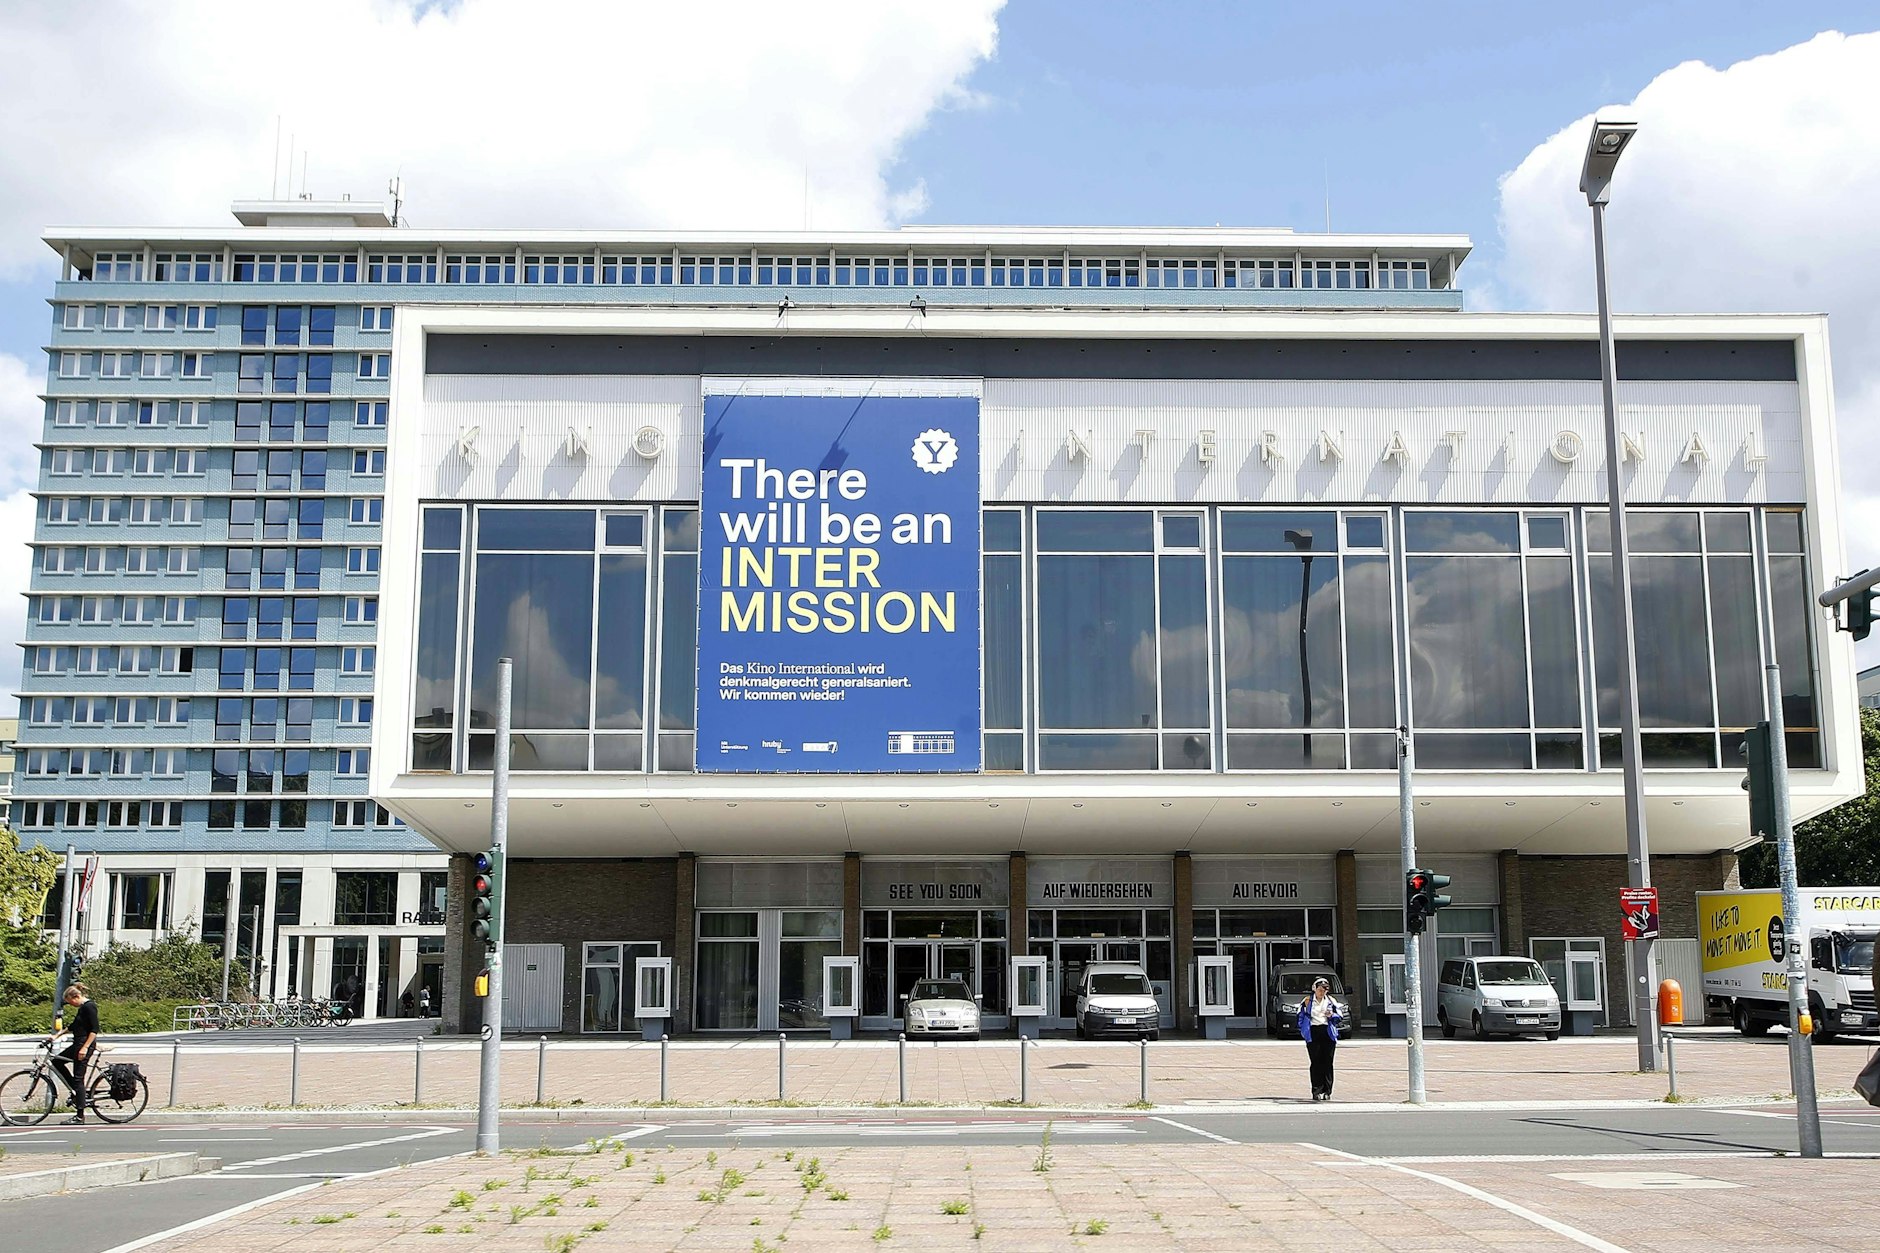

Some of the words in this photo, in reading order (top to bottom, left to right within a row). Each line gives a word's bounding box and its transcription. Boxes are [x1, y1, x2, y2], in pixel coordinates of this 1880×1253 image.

[458, 425, 664, 459] KINO
[1018, 429, 1768, 463] INTERNATIONAL
[720, 458, 867, 500] There
[719, 502, 806, 543] will
[820, 502, 882, 544] be
[891, 513, 952, 544] an
[721, 546, 882, 588] INTER
[720, 590, 956, 634] MISSION
[720, 663, 744, 674] Das
[746, 662, 776, 674] Kino
[778, 662, 855, 674] International
[857, 663, 885, 674] wird
[719, 676, 819, 689] denkmalgerecht
[821, 676, 912, 689] generalsaniert.
[719, 689, 741, 700] Wir
[744, 689, 797, 700] kommen
[799, 689, 845, 700] wieder!
[889, 883, 914, 899] SEE
[919, 883, 944, 899] YOU
[949, 883, 982, 899] SOON
[1042, 883, 1066, 898] AUF
[1069, 883, 1153, 898] WIEDERSEHEN
[1232, 883, 1250, 898] AU
[1253, 883, 1298, 898] REVOIR
[1813, 896, 1880, 911] STARCAR
[1715, 908, 1730, 931] LIKE
[1730, 905, 1740, 926] TO
[1706, 936, 1724, 958] MOVE
[1733, 930, 1752, 953] MOVE
